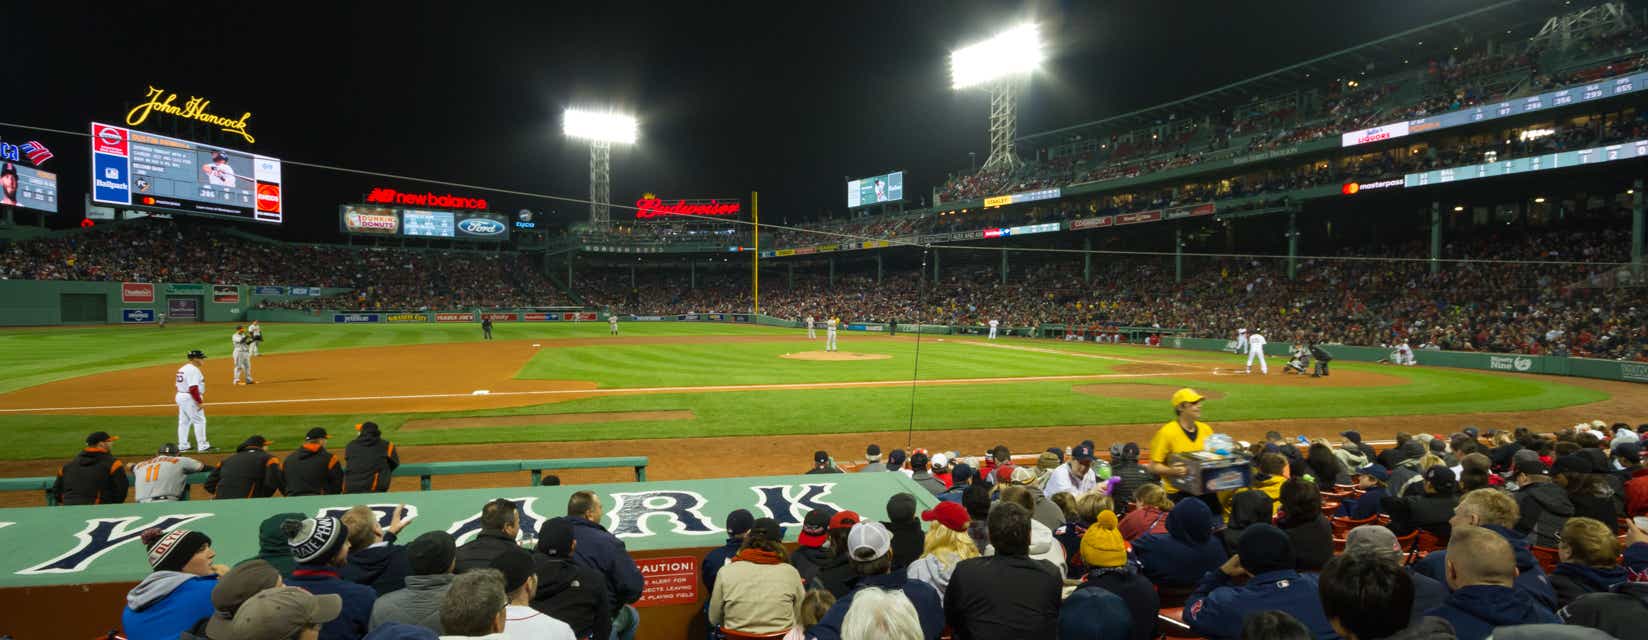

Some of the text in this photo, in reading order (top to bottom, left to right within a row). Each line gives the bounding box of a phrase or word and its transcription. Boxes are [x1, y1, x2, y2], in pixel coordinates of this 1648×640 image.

[1584, 91, 1602, 100] .299
[127, 85, 255, 144] John Hancock
[1358, 132, 1391, 144] LIQUORS
[0, 142, 20, 161] ca
[1360, 179, 1404, 190] masterpass
[636, 198, 741, 218] Budweiser
[467, 220, 496, 233] Ford
[144, 463, 161, 483] 11
[0, 512, 216, 575] Y
